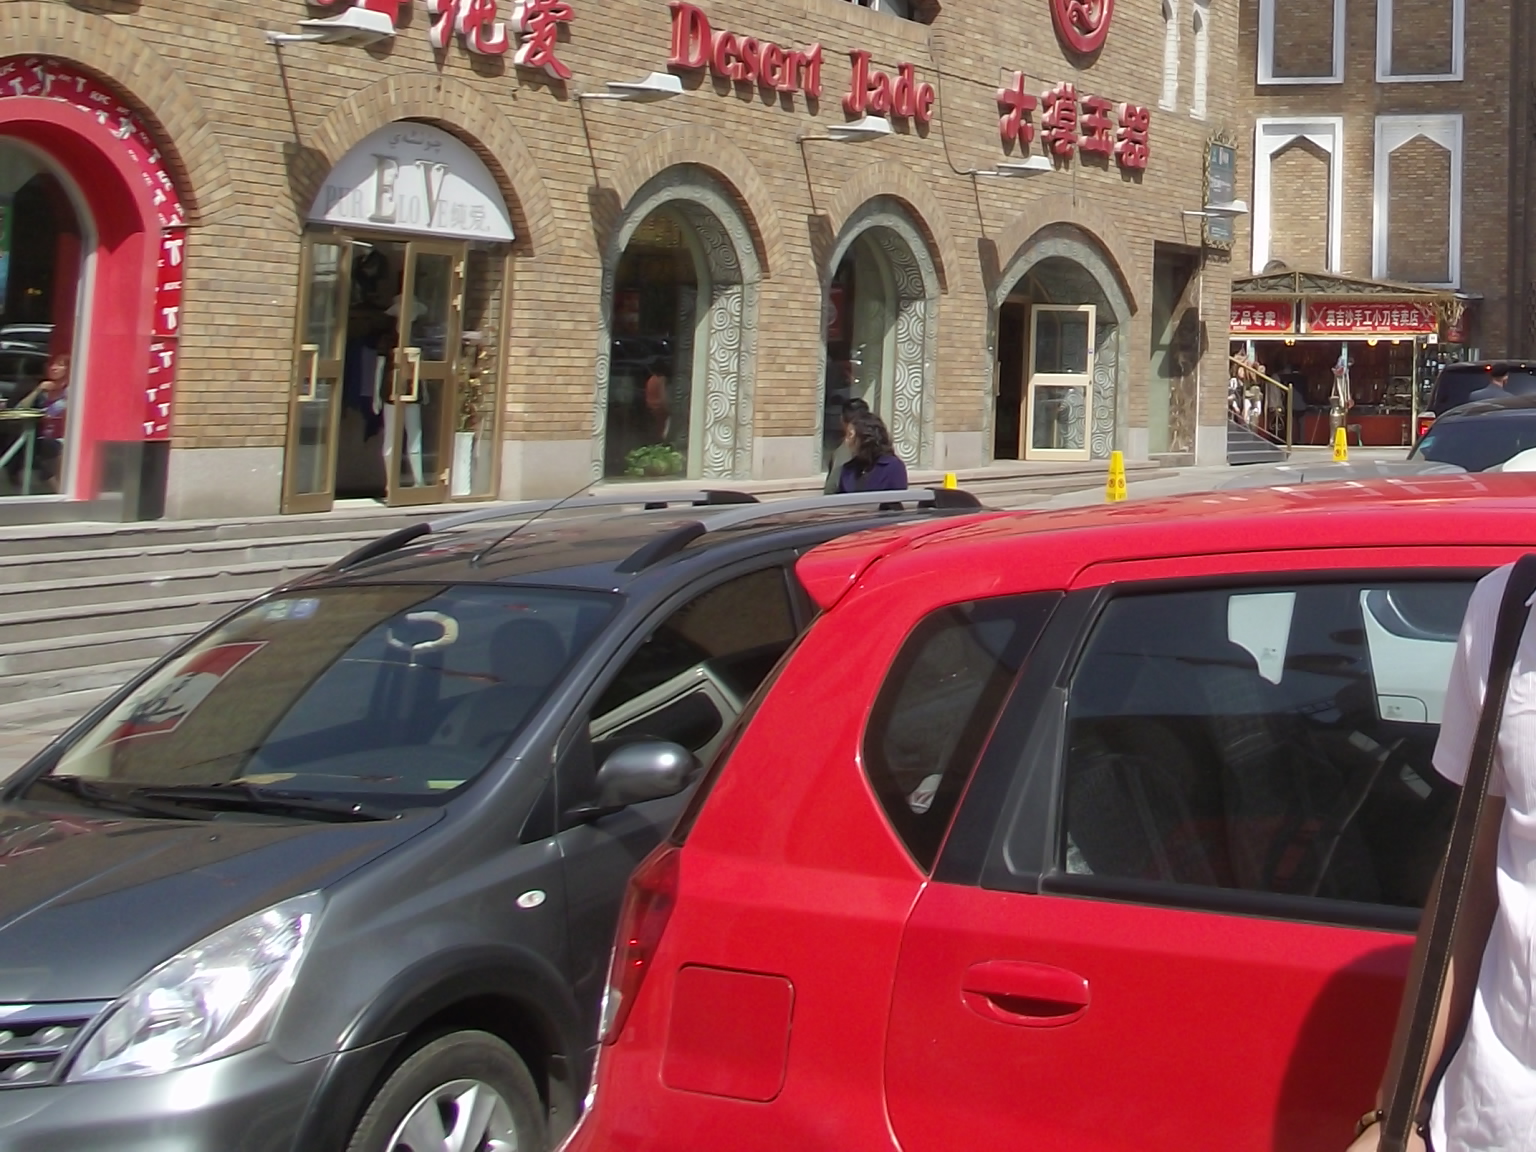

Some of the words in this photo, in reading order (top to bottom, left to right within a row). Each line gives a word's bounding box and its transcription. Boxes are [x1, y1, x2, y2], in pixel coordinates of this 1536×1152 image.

[667, 0, 825, 99] Desert
[841, 48, 936, 124] Jade
[995, 70, 1152, 170] 大漠玉器
